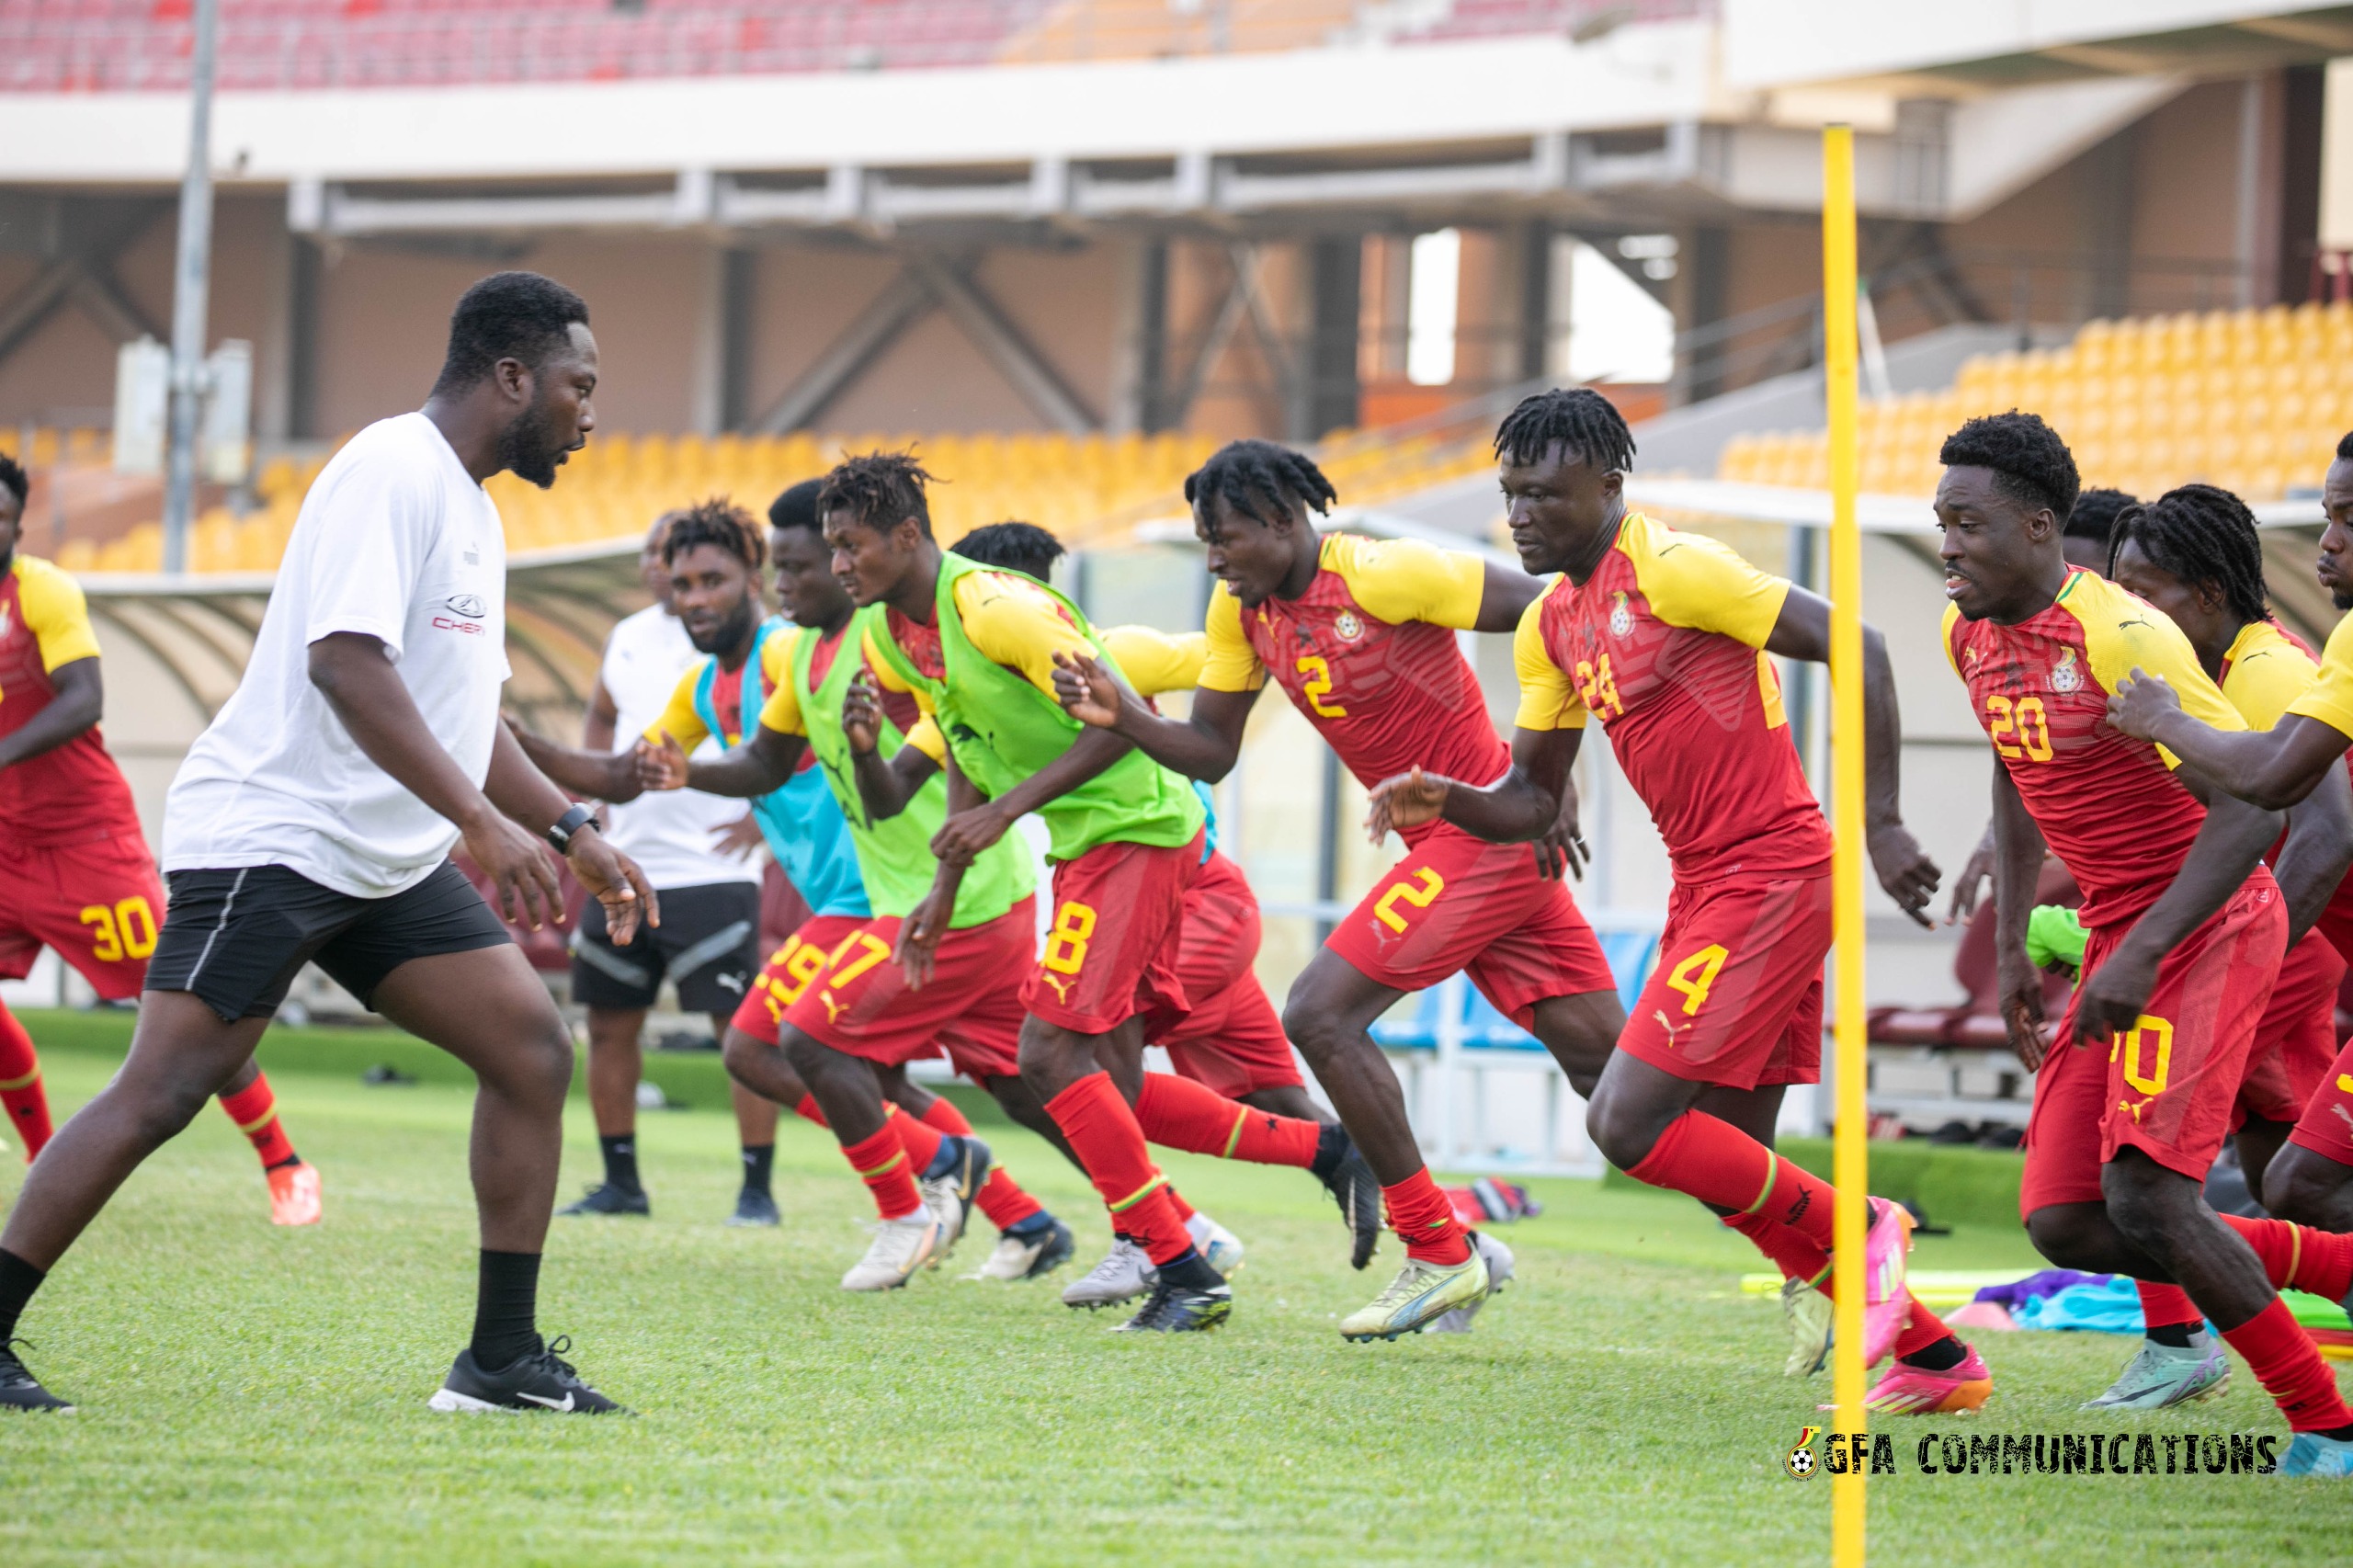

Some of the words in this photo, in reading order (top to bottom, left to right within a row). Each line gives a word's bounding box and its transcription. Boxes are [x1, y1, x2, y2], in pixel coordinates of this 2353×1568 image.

[1295, 655, 1347, 718] 2
[1575, 653, 1624, 719] 24
[1986, 695, 2054, 762] 20
[80, 895, 158, 961] 30
[1373, 866, 1444, 935] 2
[827, 929, 892, 990] 17
[1666, 943, 1730, 1017] 4
[2109, 1014, 2174, 1096] 0
